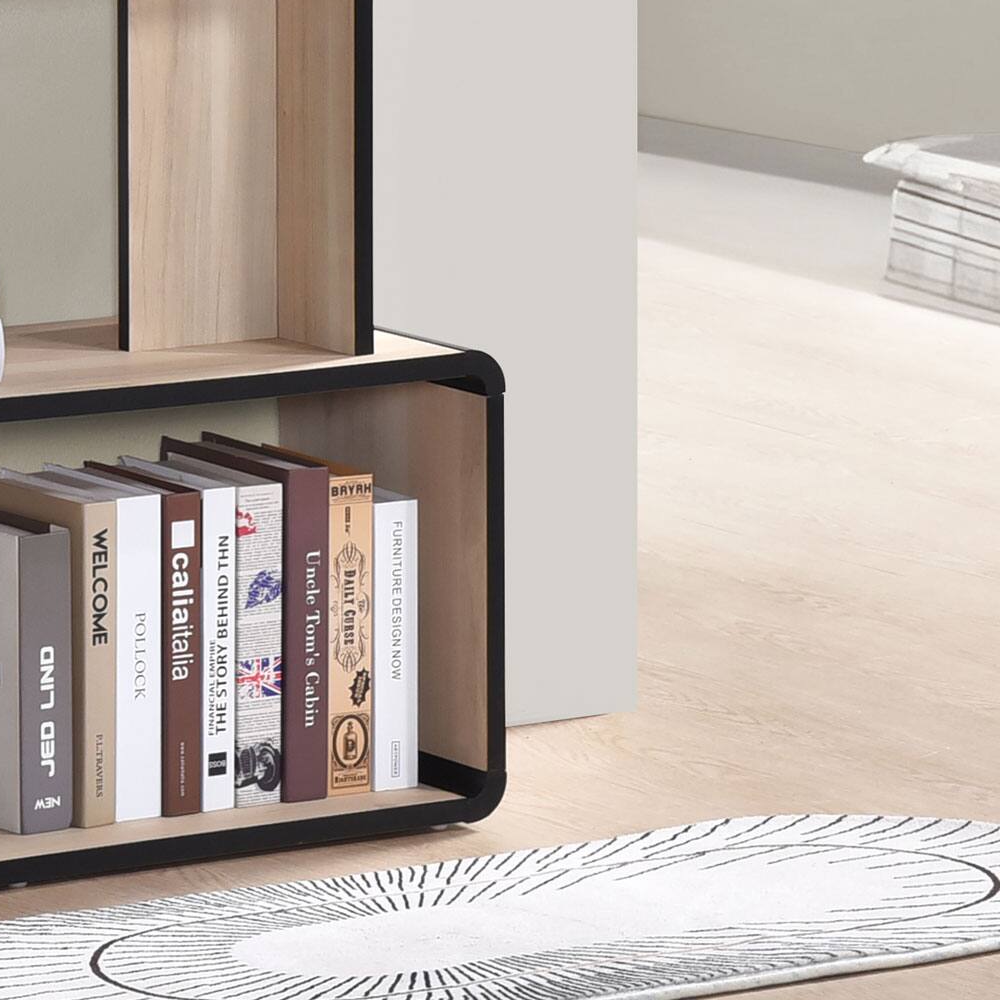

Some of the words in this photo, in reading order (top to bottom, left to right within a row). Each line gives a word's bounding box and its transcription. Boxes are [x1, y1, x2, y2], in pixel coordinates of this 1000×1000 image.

[218, 535, 230, 571] THN
[305, 551, 320, 604] Uncle
[392, 521, 403, 596] FURNITURE
[91, 528, 109, 646] WELCOME
[217, 575, 229, 639] BEHIND
[343, 569, 357, 605] DAILY
[172, 552, 194, 681] caliaitalia
[305, 608, 320, 666] Tom's
[343, 609, 357, 647] CURSE
[391, 598, 402, 647] DESIGN
[40, 645, 55, 710] LIND
[134, 612, 147, 699] POLLOCK
[208, 639, 216, 678] EMPIRE
[215, 644, 228, 698] STORY
[391, 650, 402, 681] NOW
[207, 679, 215, 736] FINANCIAL
[215, 702, 228, 736] THE
[305, 670, 320, 728] Cabin
[40, 721, 56, 777] JED
[34, 795, 62, 811] NEW
